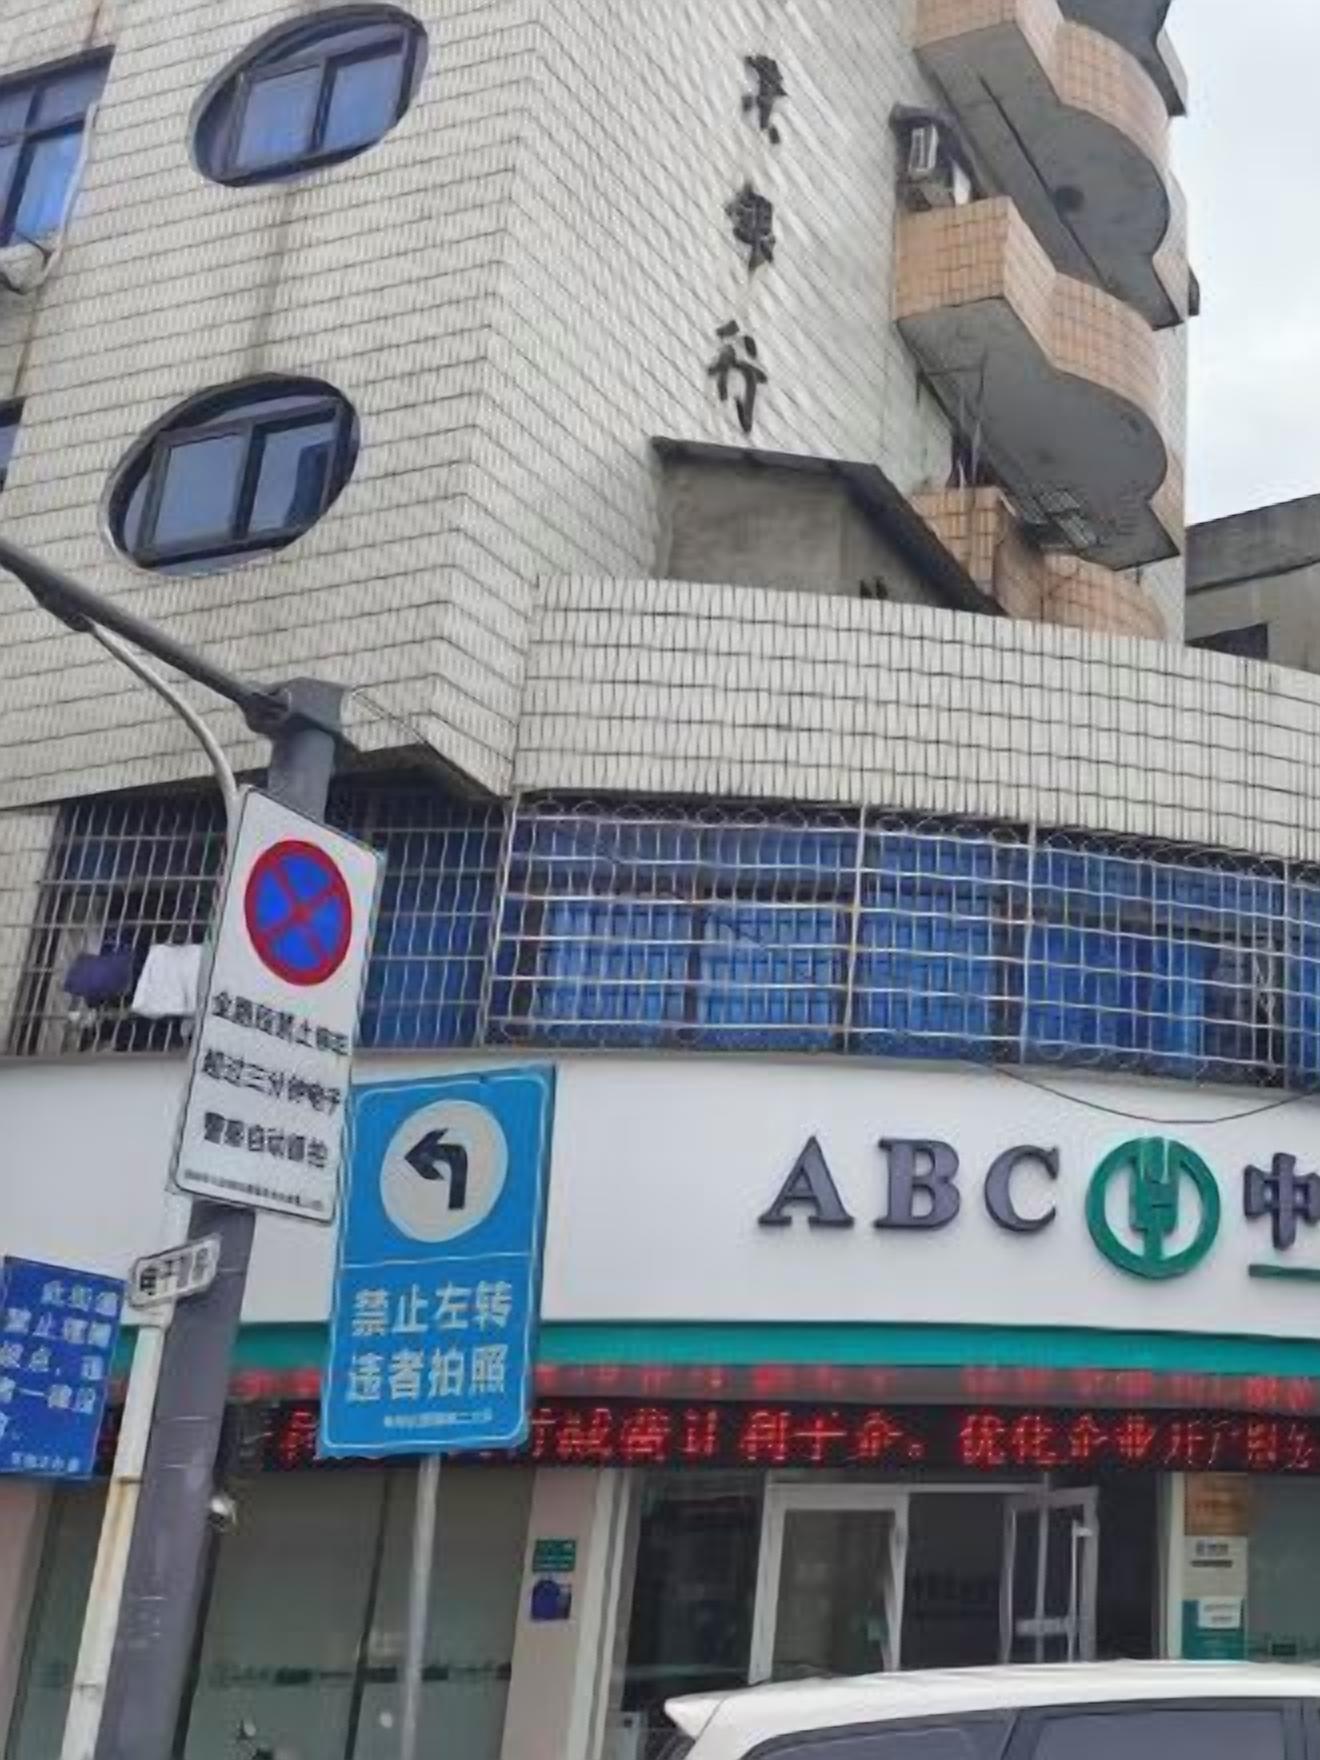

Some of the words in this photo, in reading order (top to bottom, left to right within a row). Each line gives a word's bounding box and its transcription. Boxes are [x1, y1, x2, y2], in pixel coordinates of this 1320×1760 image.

[202, 1047, 341, 1116] 超过三分钟电子
[758, 1134, 1061, 1233] ABC
[352, 1280, 513, 1337] 禁止左转
[346, 1343, 509, 1402] 违者拍照
